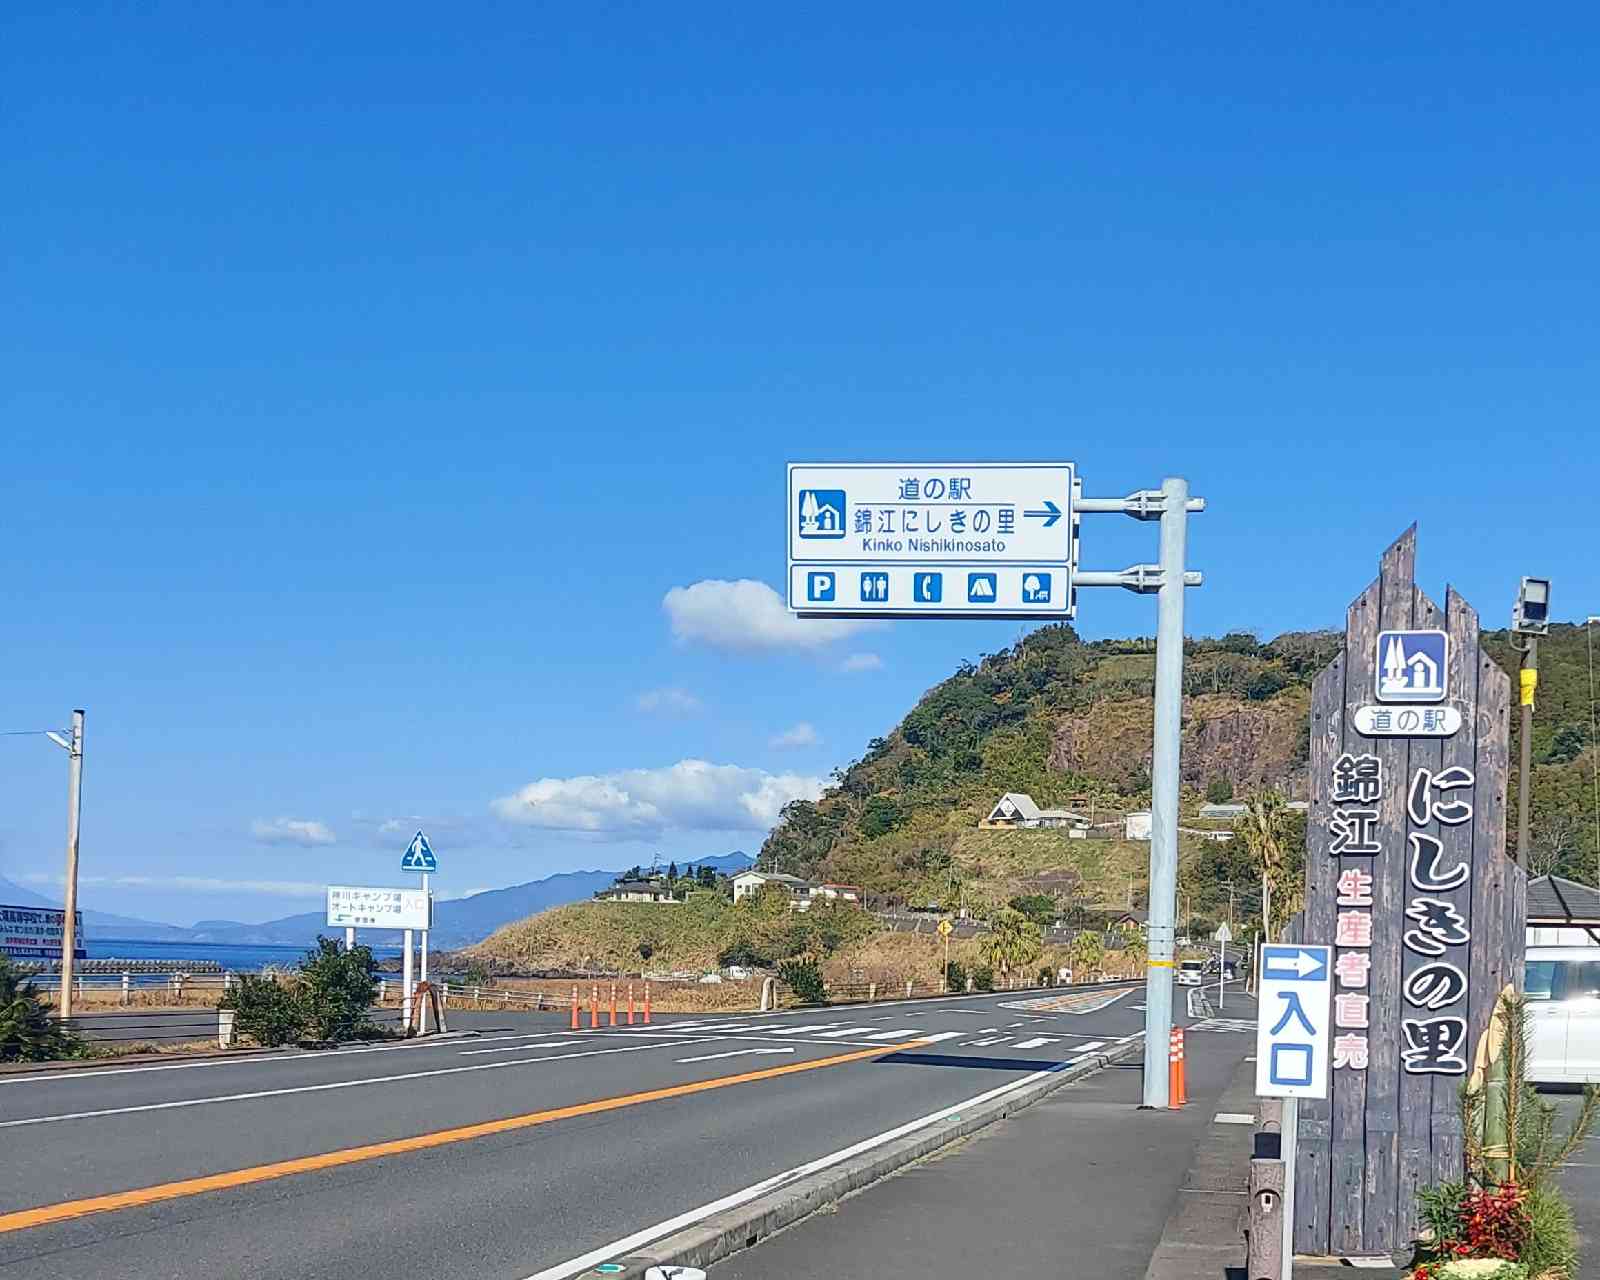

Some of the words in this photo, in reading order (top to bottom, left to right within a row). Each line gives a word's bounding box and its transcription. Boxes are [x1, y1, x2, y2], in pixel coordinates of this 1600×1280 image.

[898, 477, 972, 501] 道の駅
[854, 508, 1016, 535] 錦江にしきの里
[862, 538, 903, 552] Kinko
[908, 538, 1006, 553] Nishikinosato
[813, 576, 832, 599] P
[1369, 709, 1447, 733] 道の駅
[1330, 753, 1383, 855] 錦江
[1401, 766, 1475, 1074] にしきの里
[1333, 868, 1373, 1070] 生産者直売
[1269, 991, 1317, 1087] 入口
